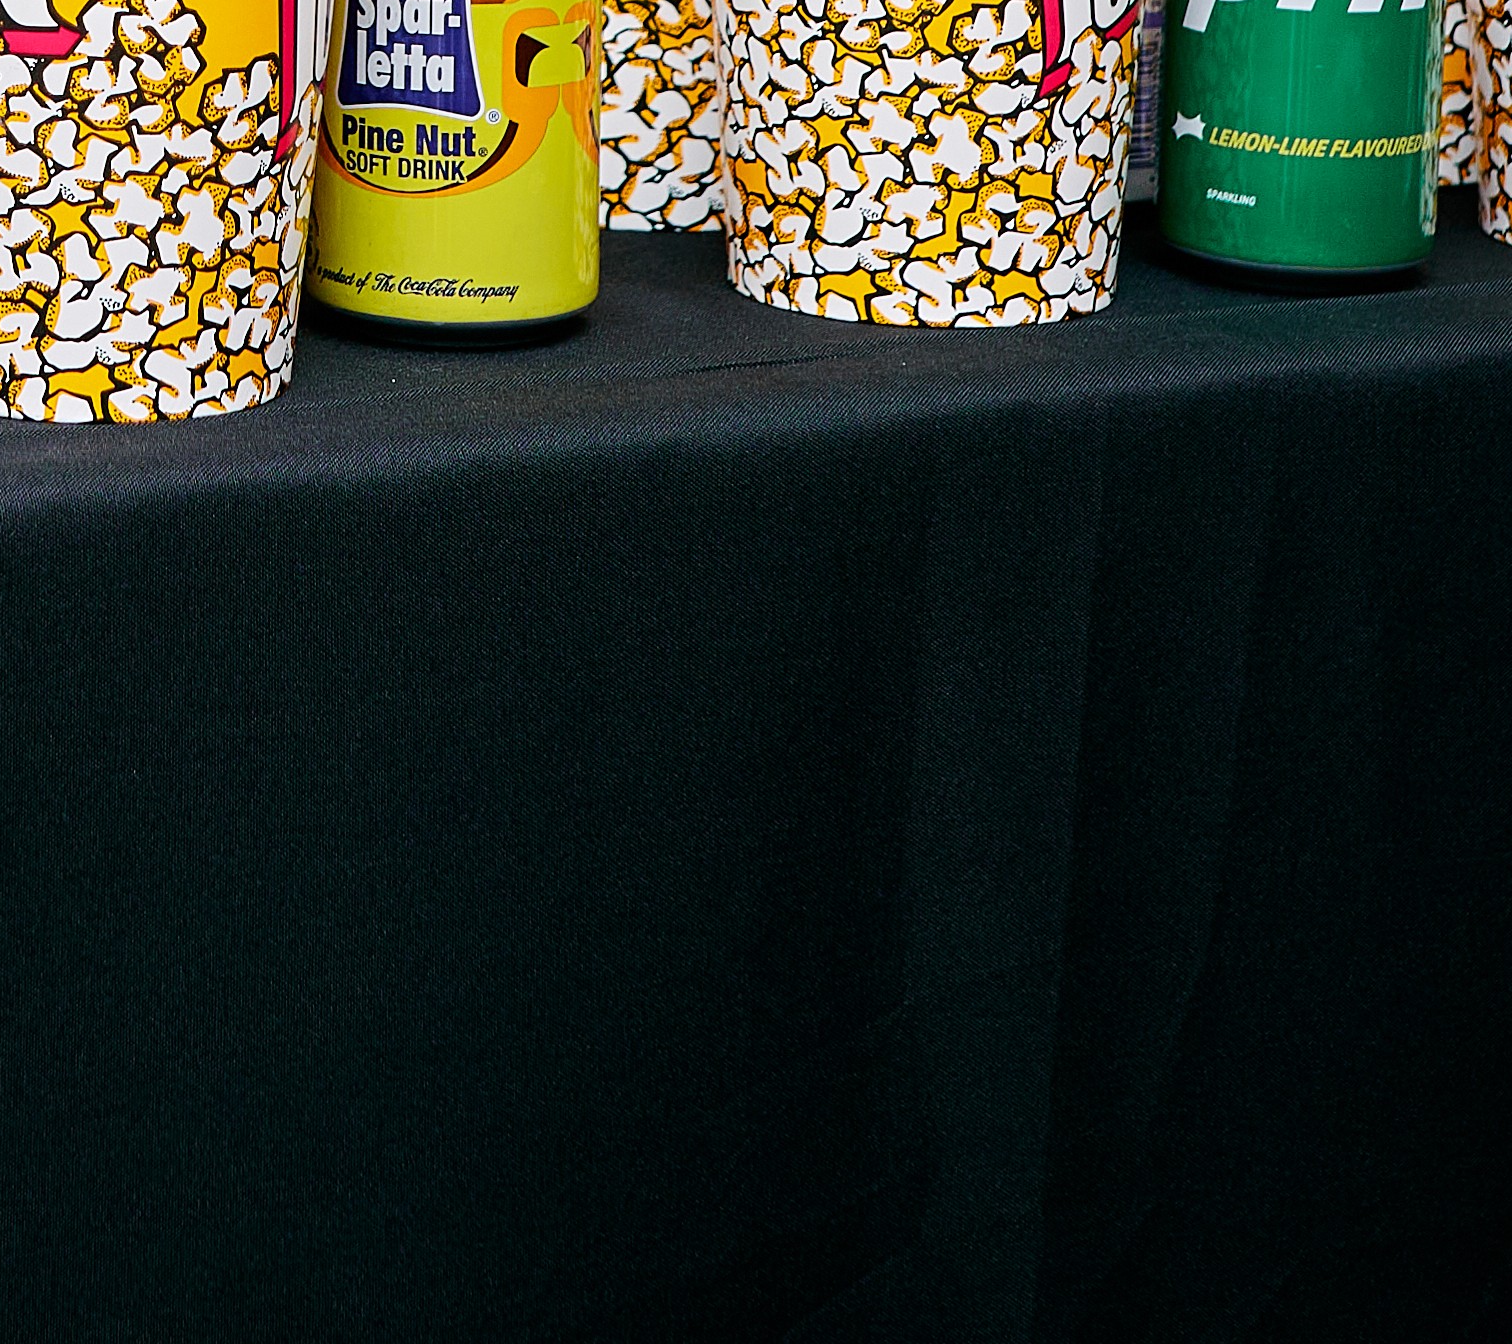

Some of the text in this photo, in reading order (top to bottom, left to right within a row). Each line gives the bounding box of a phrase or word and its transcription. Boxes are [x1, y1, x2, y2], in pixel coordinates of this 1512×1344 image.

[356, 29, 455, 93] letta
[342, 113, 477, 157] Pine Nut
[1208, 126, 1330, 158] LEMON-LIME
[1329, 133, 1423, 158] FLAVOURED
[346, 149, 467, 182] SOFT DRINK
[1206, 187, 1257, 207] SPARKLING
[355, 270, 372, 294] of
[372, 272, 396, 293] The
[397, 276, 463, 297] Coca-Cola
[458, 278, 520, 304] Company
